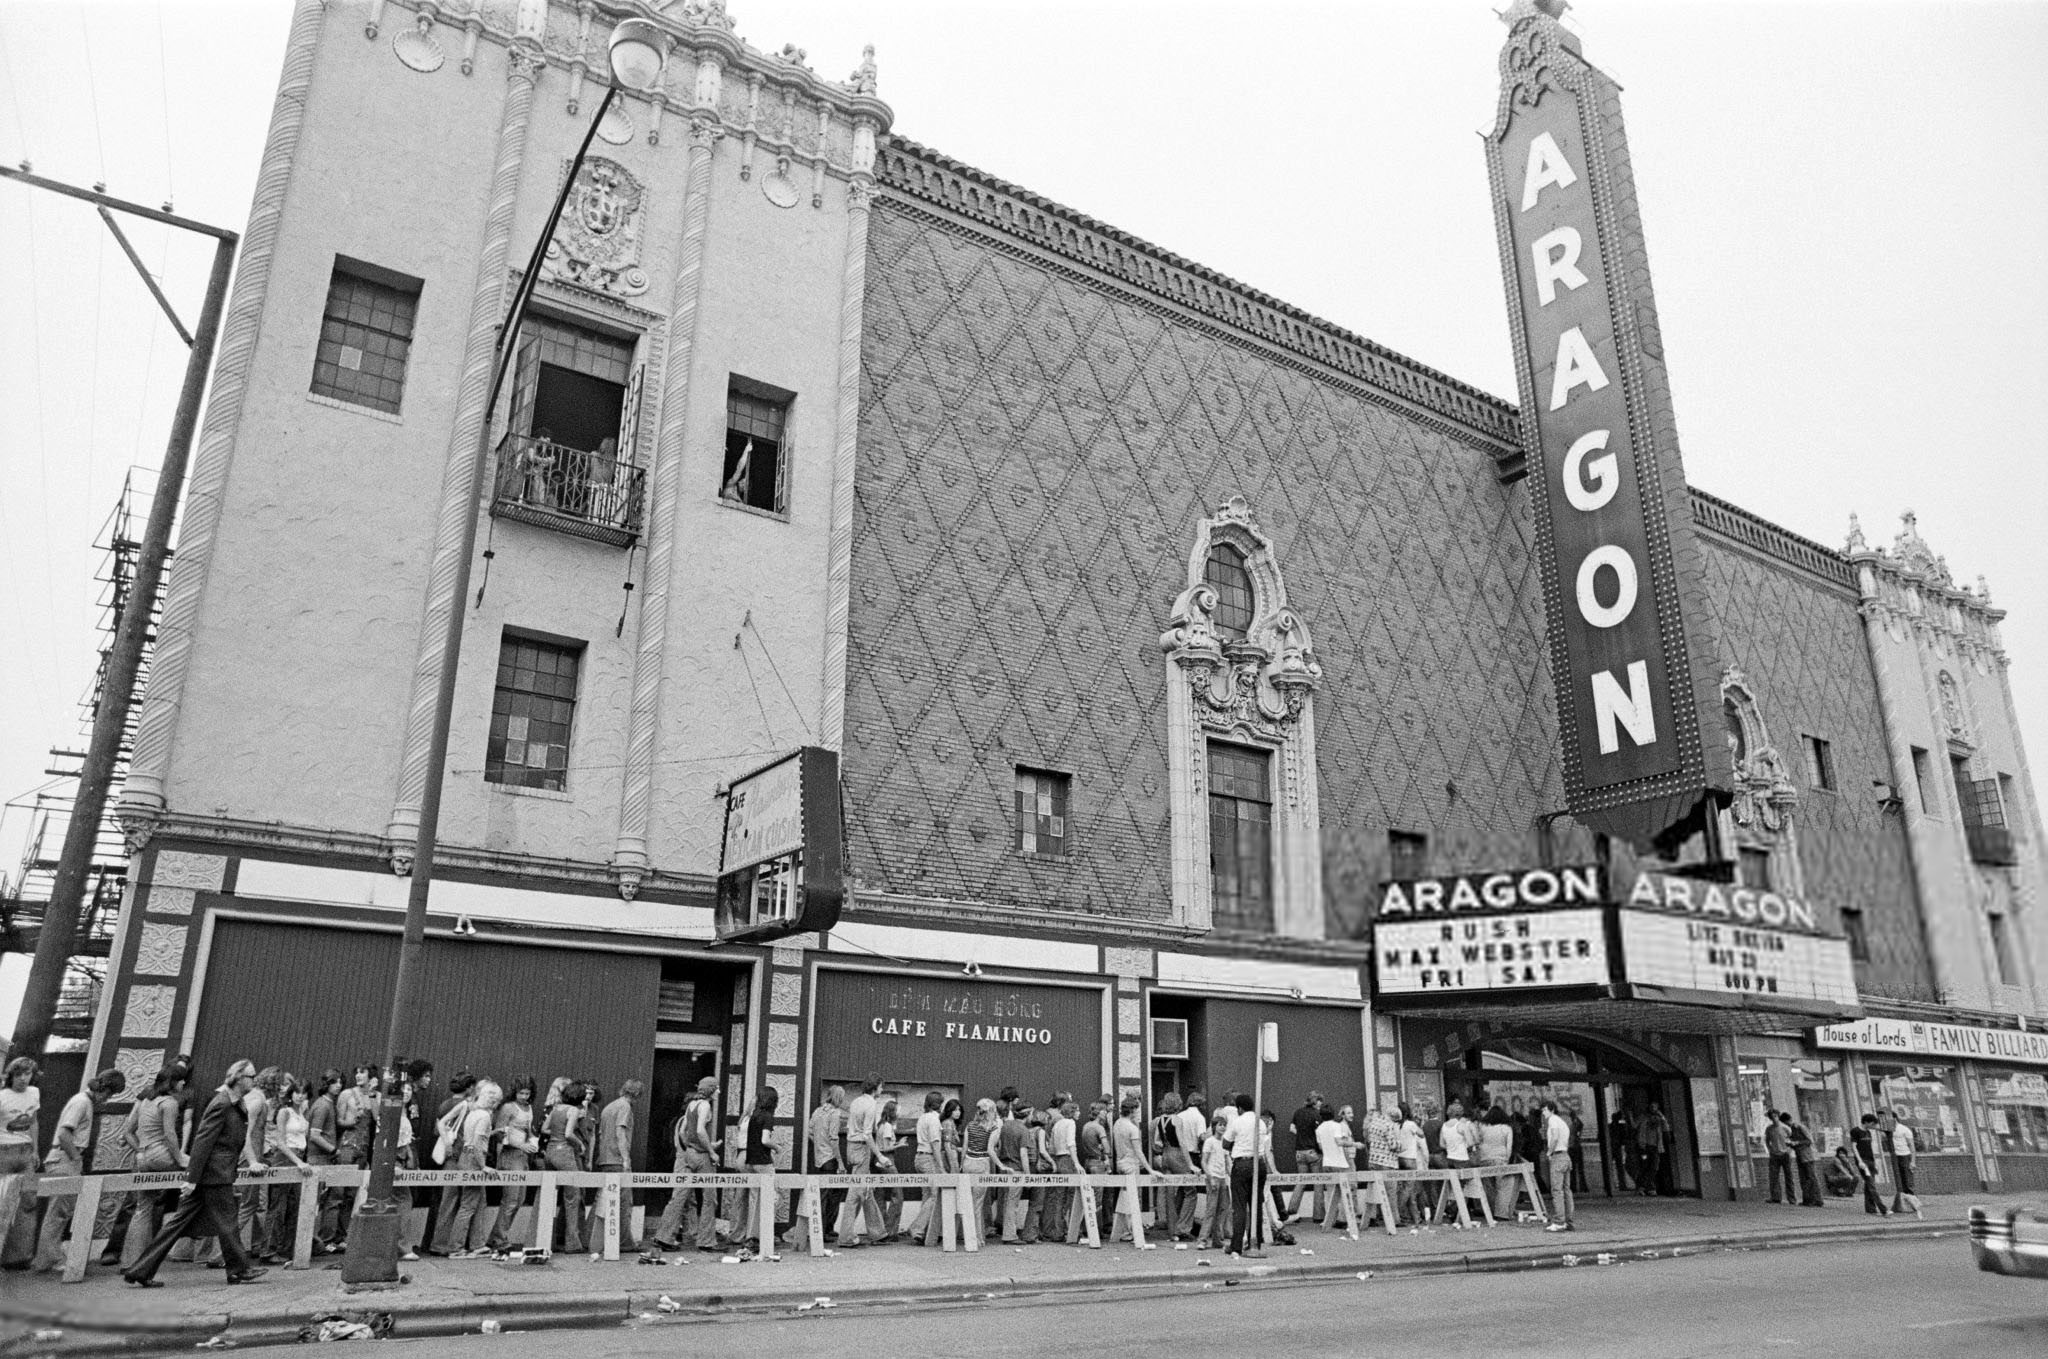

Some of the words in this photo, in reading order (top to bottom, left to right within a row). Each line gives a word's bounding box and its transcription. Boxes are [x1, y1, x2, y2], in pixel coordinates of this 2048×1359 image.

[1521, 131, 1657, 755] ARAGON
[730, 791, 747, 812] CAFE
[1380, 867, 1600, 915] ARAGON
[1630, 872, 1815, 929] ARAGON
[1441, 919, 1530, 941] RUSH
[1385, 946, 1440, 968] MAX
[1462, 939, 1591, 963] WEBSTER
[1421, 970, 1463, 988] FRI
[1502, 964, 1554, 984] SAT
[871, 1017, 927, 1037] CAFE
[945, 1022, 1052, 1045] FLAMINGO
[1823, 1025, 1857, 1043] House
[1862, 1024, 1871, 1044] of
[1876, 1023, 1906, 1047] Lords
[1930, 1027, 1982, 1054] FAMILY
[133, 1173, 176, 1184] BUREAU
[444, 1173, 458, 1182] OF
[632, 1175, 671, 1184] BUREAU
[675, 1175, 688, 1184] OF
[691, 1175, 748, 1184] SANITATION
[828, 1175, 862, 1184] BUREAU
[865, 1175, 877, 1184] OF
[879, 1175, 929, 1184] SANITATION
[978, 1175, 1009, 1184] BUREAU
[1012, 1175, 1022, 1184] OF
[1024, 1175, 1069, 1184] SANITATION
